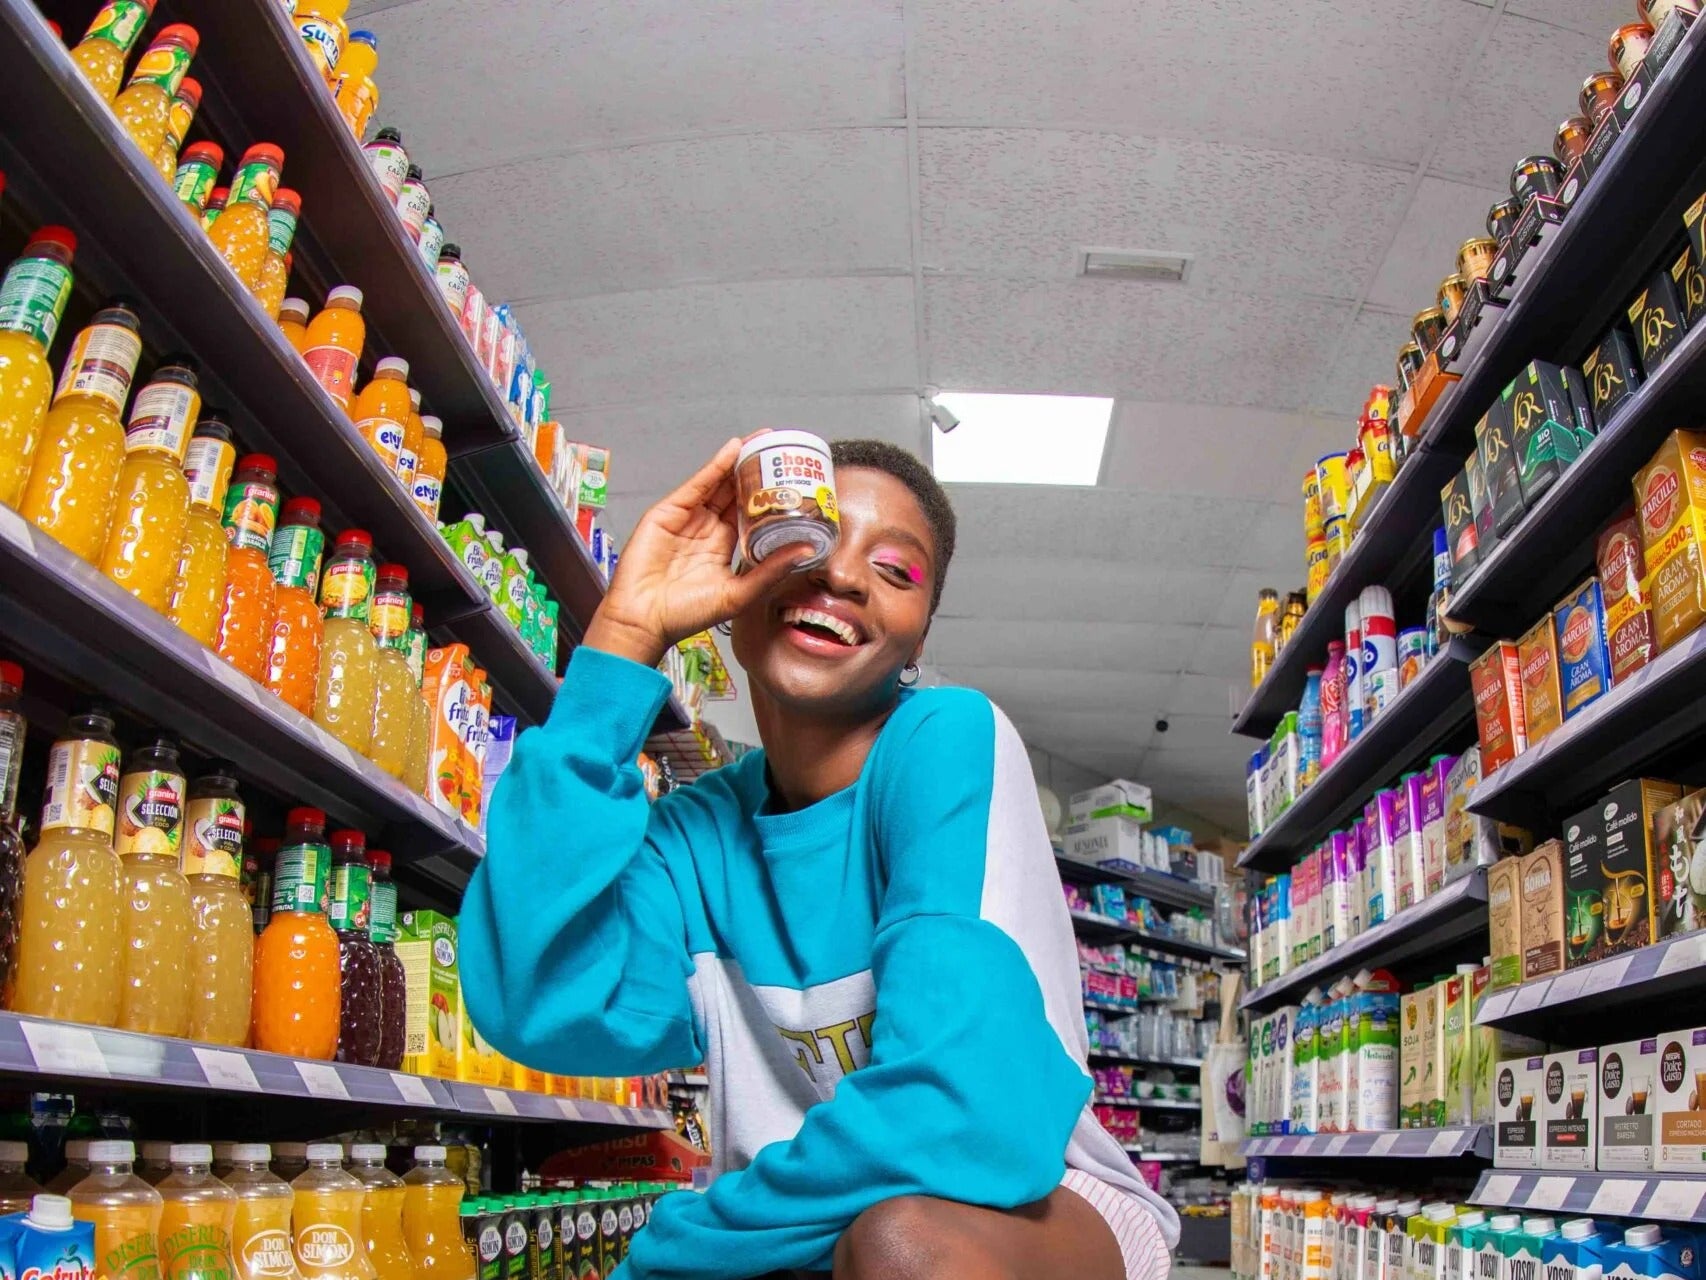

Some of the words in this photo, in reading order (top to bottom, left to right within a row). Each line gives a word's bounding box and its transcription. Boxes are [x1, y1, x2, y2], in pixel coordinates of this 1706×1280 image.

[772, 452, 823, 471] choco
[773, 466, 826, 483] cream
[1642, 476, 1677, 519] MARCILLA
[332, 564, 361, 574] granini
[1658, 555, 1683, 586] GRAN
[1657, 569, 1689, 600] AROMA
[1561, 617, 1593, 649] MARCILLA
[1615, 618, 1640, 644] GRAN
[1615, 630, 1646, 660] AROMA
[1523, 651, 1550, 681] MARCILLA
[1571, 660, 1590, 678] GRAN
[1570, 668, 1593, 689] AROMA
[1477, 680, 1502, 704] MARCILLA
[1606, 821, 1619, 833] Café
[1618, 812, 1637, 826] molido
[1568, 841, 1581, 853] Café
[1580, 834, 1598, 848] molido
[1404, 1034, 1419, 1046] SOJA
[1676, 1120, 1702, 1128] CORTADO
[1581, 1148, 1586, 1160] 7
[1644, 1148, 1649, 1160] 9
[1663, 1147, 1667, 1160] 8
[263, 1238, 285, 1251] DON
[312, 1232, 337, 1243] DON
[482, 1240, 499, 1254] SIMON
[303, 1243, 349, 1259] SIMON
[1418, 1243, 1435, 1266] YOSOY
[1479, 1252, 1498, 1280] YOSOY
